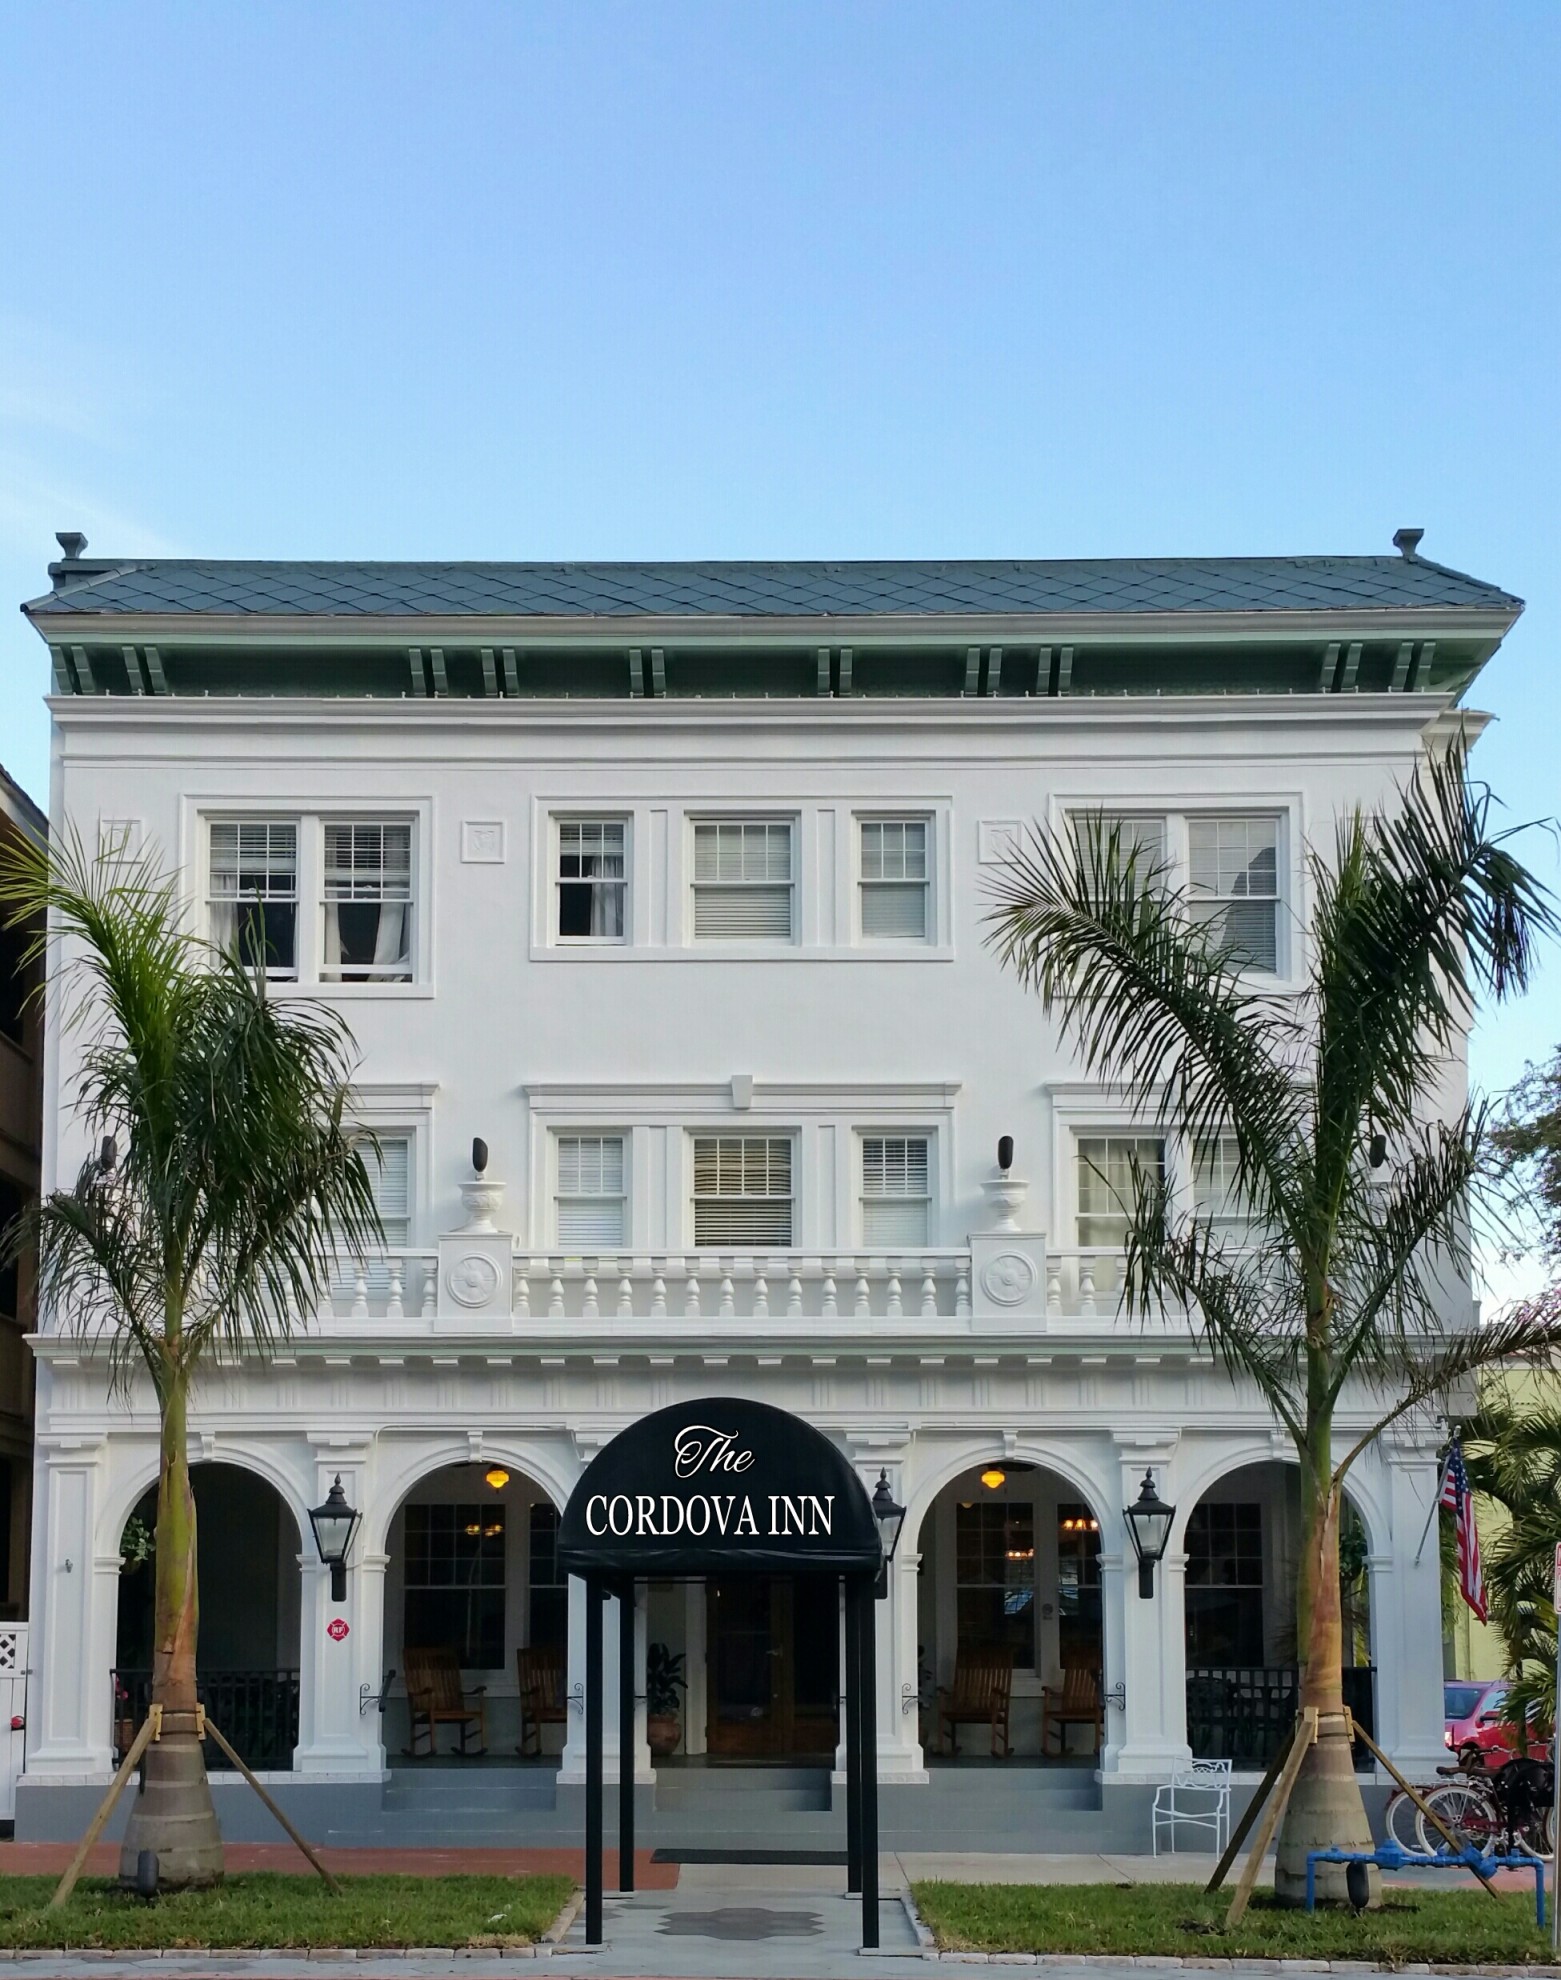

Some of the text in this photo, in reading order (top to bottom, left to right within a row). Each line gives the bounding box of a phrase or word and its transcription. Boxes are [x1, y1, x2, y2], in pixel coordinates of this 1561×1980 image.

[674, 1425, 755, 1478] The
[585, 1494, 835, 1536] CORDOVA INN
